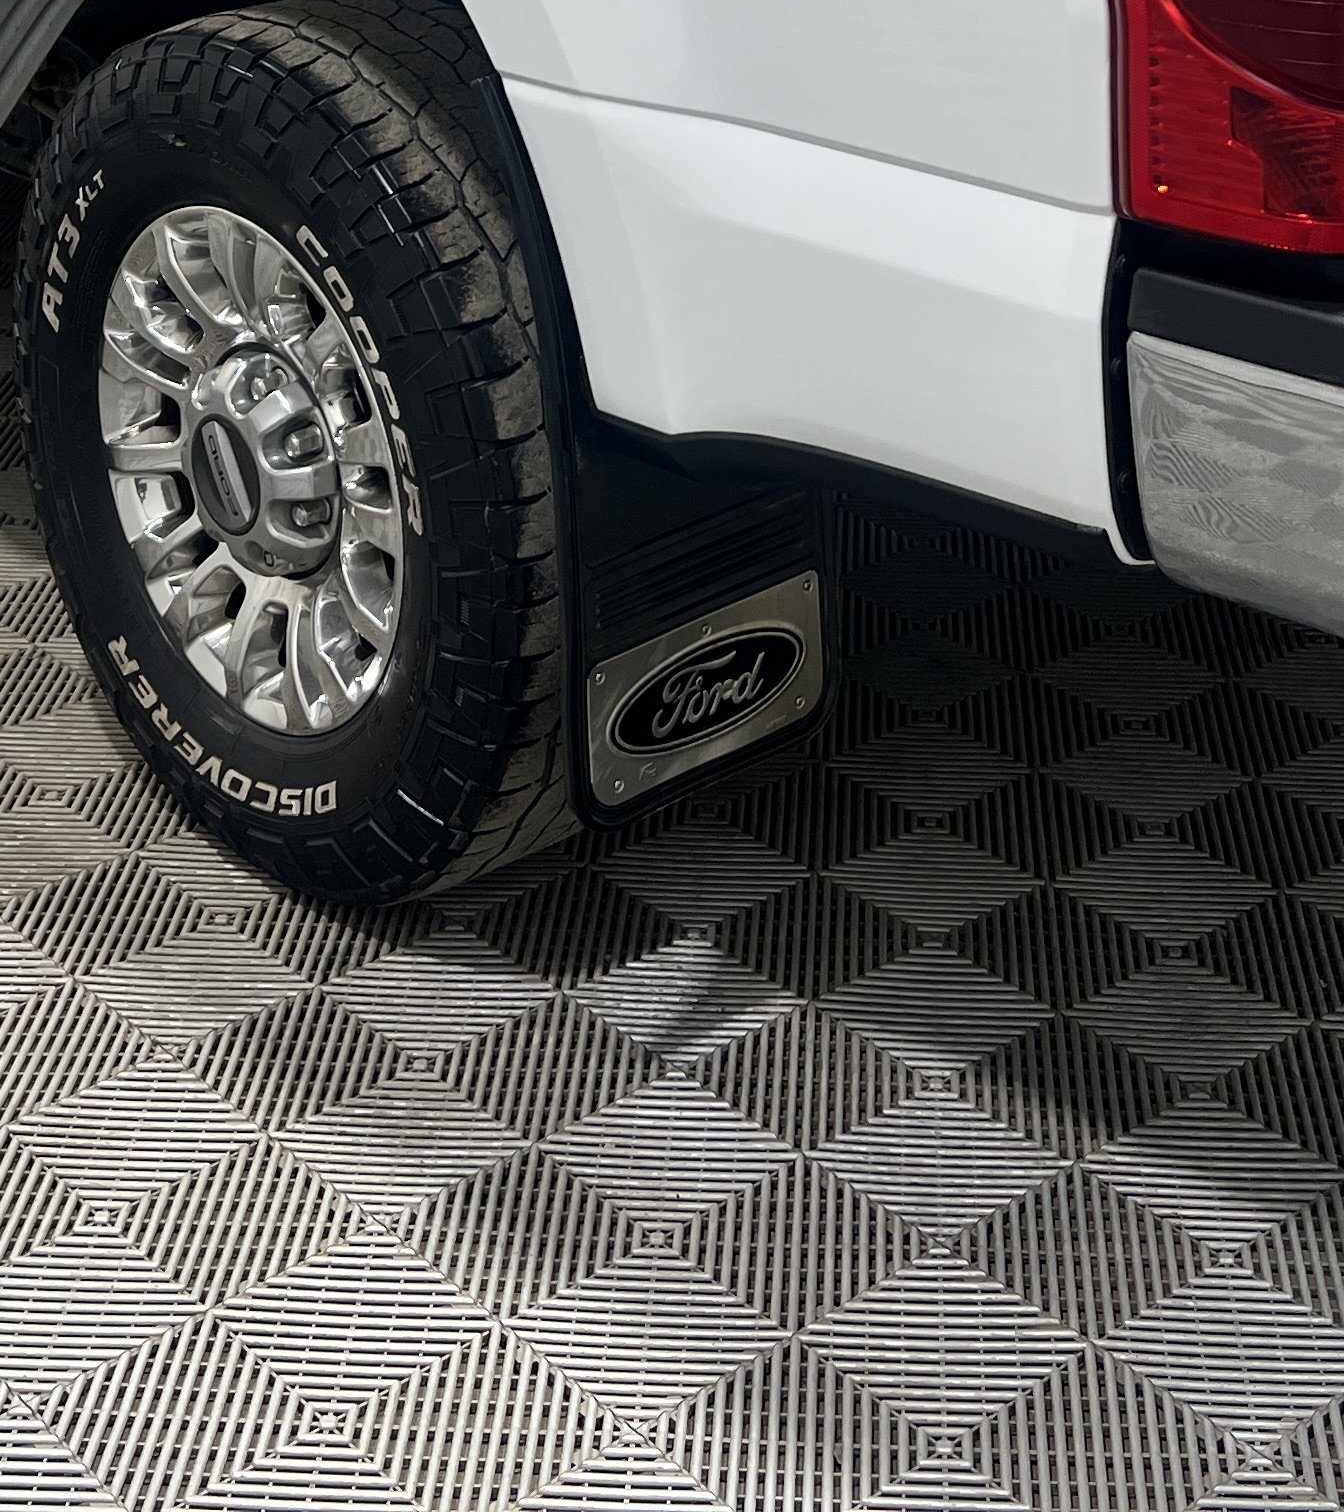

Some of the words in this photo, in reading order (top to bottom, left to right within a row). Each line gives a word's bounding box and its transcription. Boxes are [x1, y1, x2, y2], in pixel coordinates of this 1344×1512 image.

[41, 212, 80, 334] AT3
[74, 168, 105, 222] XLT
[295, 225, 424, 536] COOPER
[107, 635, 338, 817] DISCOVERER
[651, 649, 766, 739] Ford
